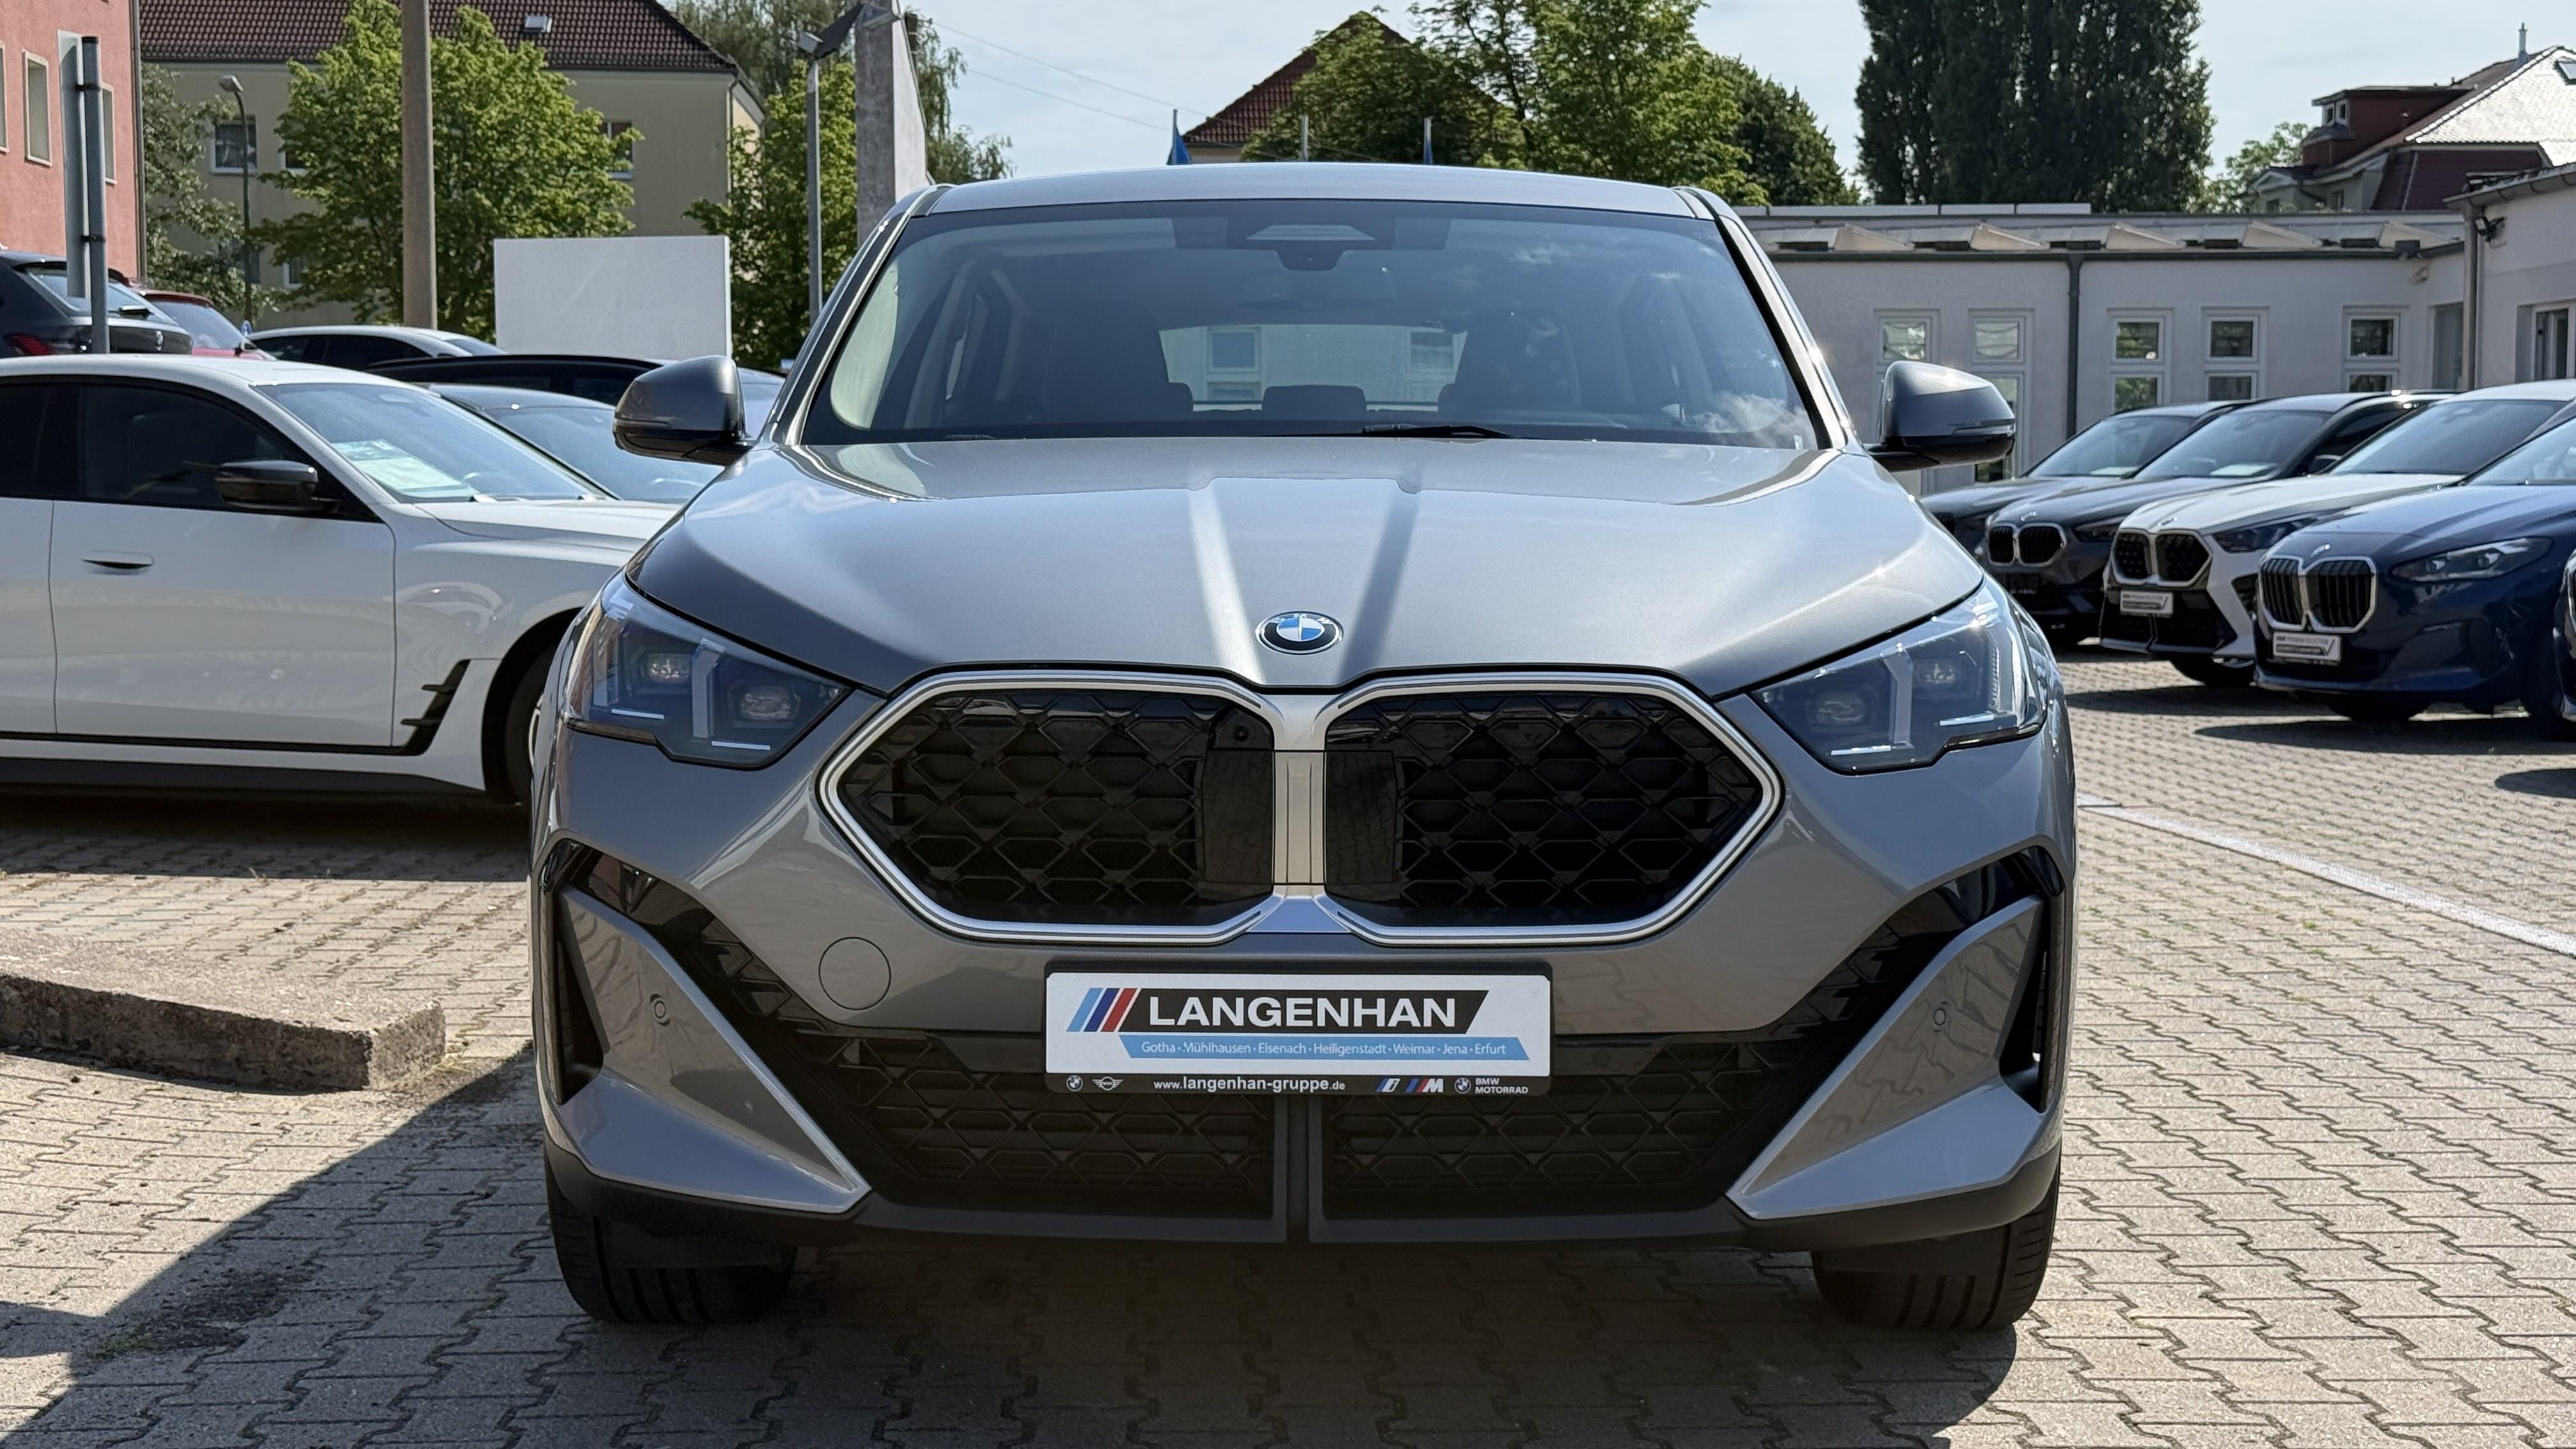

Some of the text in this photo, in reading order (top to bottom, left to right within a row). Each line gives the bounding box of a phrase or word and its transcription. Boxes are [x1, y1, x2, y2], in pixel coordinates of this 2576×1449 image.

[1149, 996, 1455, 1027] LANGENHAN
[1141, 1041, 1506, 1056] Gotha Mühlhausen Eisenach Heiligenstadt Weimar Jena Erfurt
[1153, 1075, 1346, 1093] www.langenhan-gruppe.de
[1422, 1078, 1444, 1092] M
